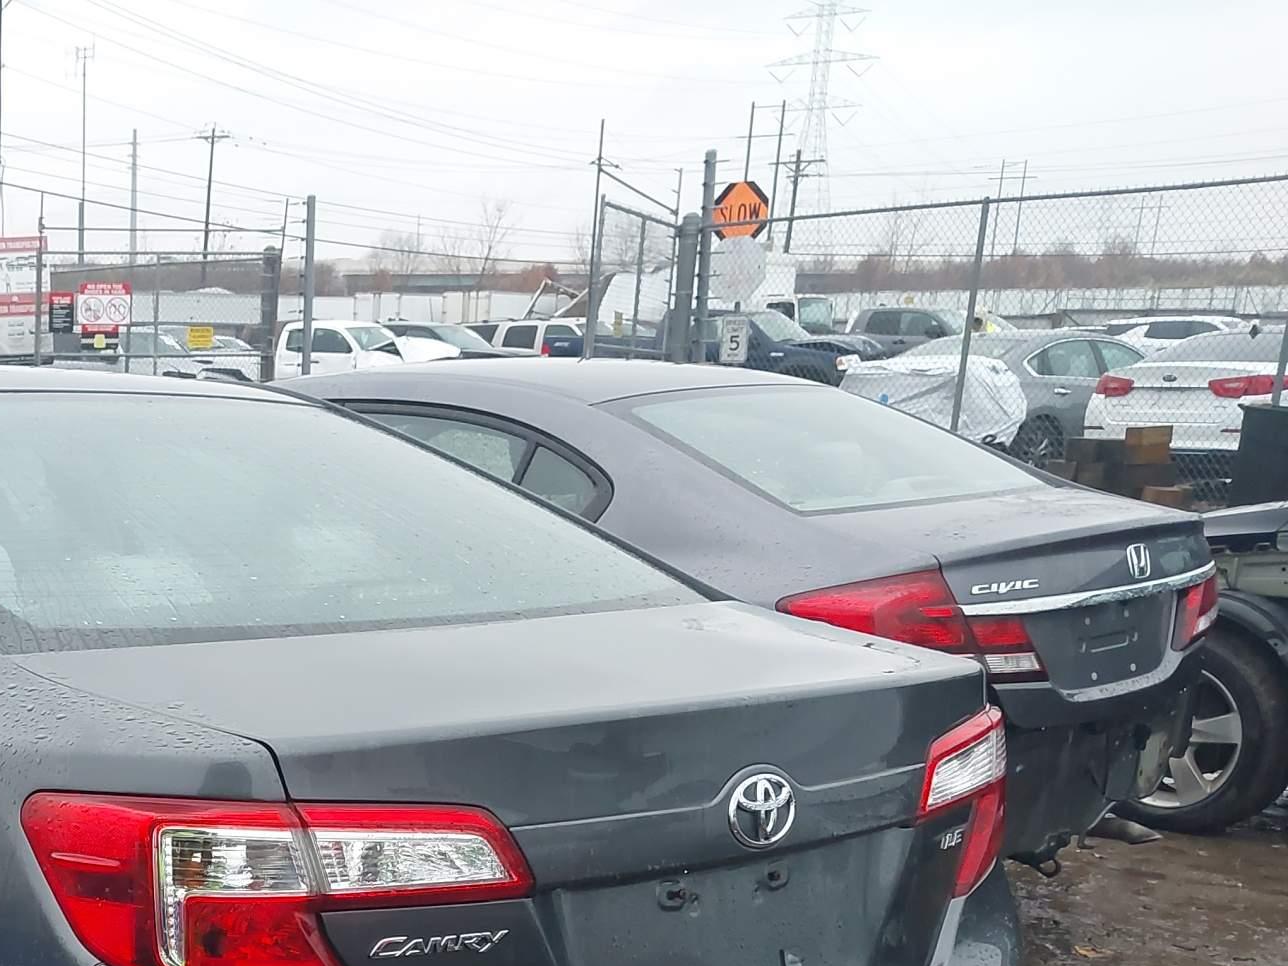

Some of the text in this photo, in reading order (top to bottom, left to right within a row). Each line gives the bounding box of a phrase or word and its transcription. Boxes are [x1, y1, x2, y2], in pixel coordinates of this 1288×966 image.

[720, 203, 761, 223] SLOW
[728, 335, 740, 351] 5
[970, 579, 1040, 595] CIVIC
[369, 929, 509, 958] CAMRY
